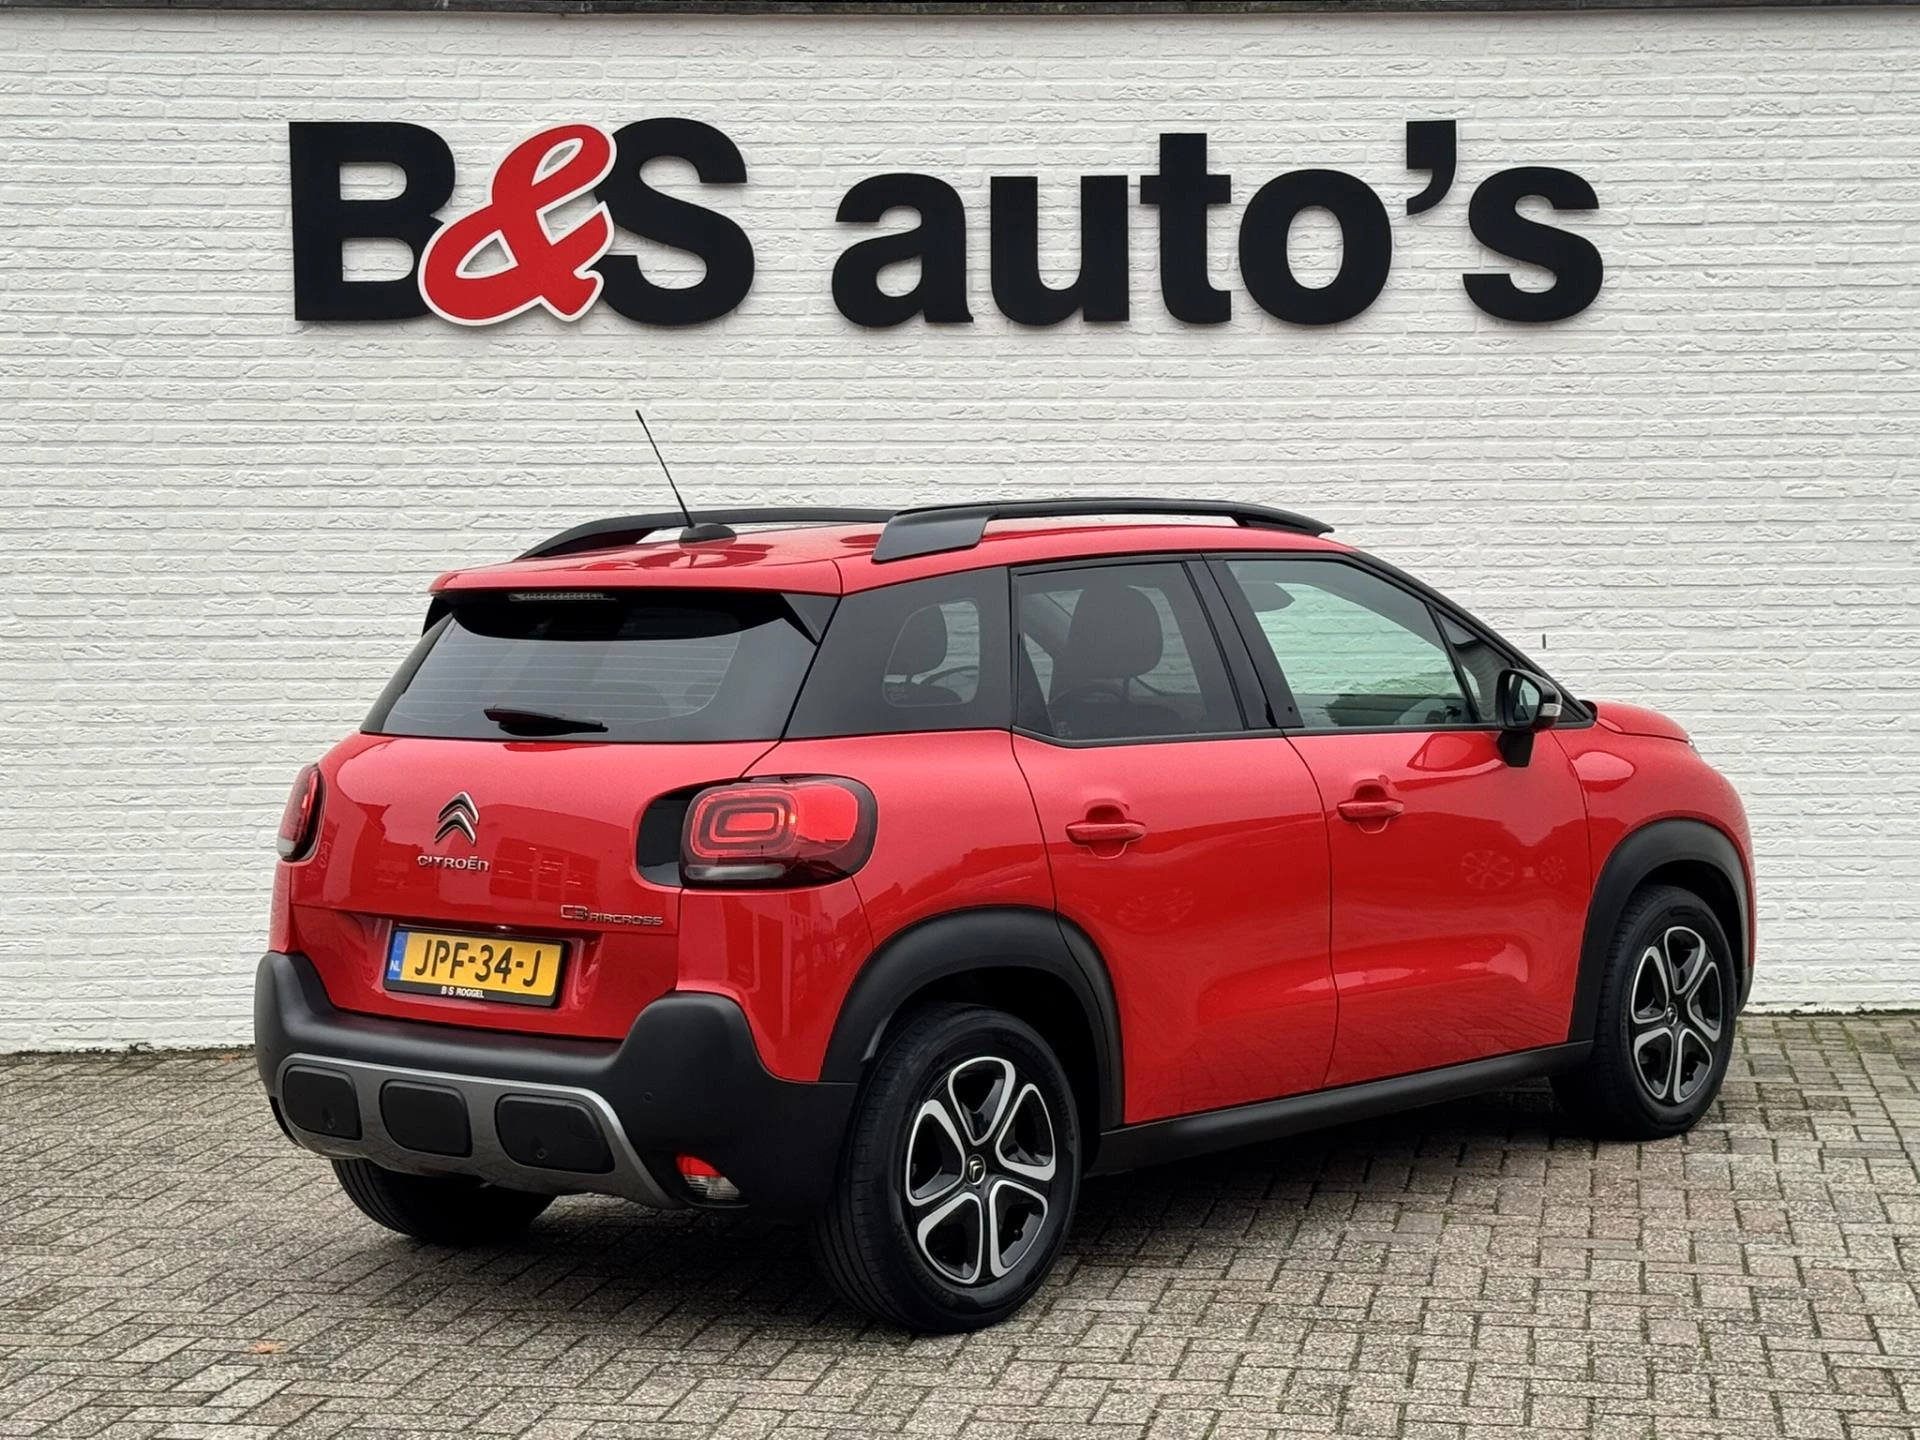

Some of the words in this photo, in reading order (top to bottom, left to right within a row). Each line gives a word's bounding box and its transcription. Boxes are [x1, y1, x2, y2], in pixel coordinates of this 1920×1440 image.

[289, 117, 755, 326] B&S
[831, 120, 1604, 328] auto's
[560, 904, 588, 920] C3
[589, 912, 664, 926] AIRCROSS
[389, 960, 401, 972] NL
[414, 939, 542, 987] JPF-34-J
[441, 985, 448, 995] B
[448, 986, 455, 996] S
